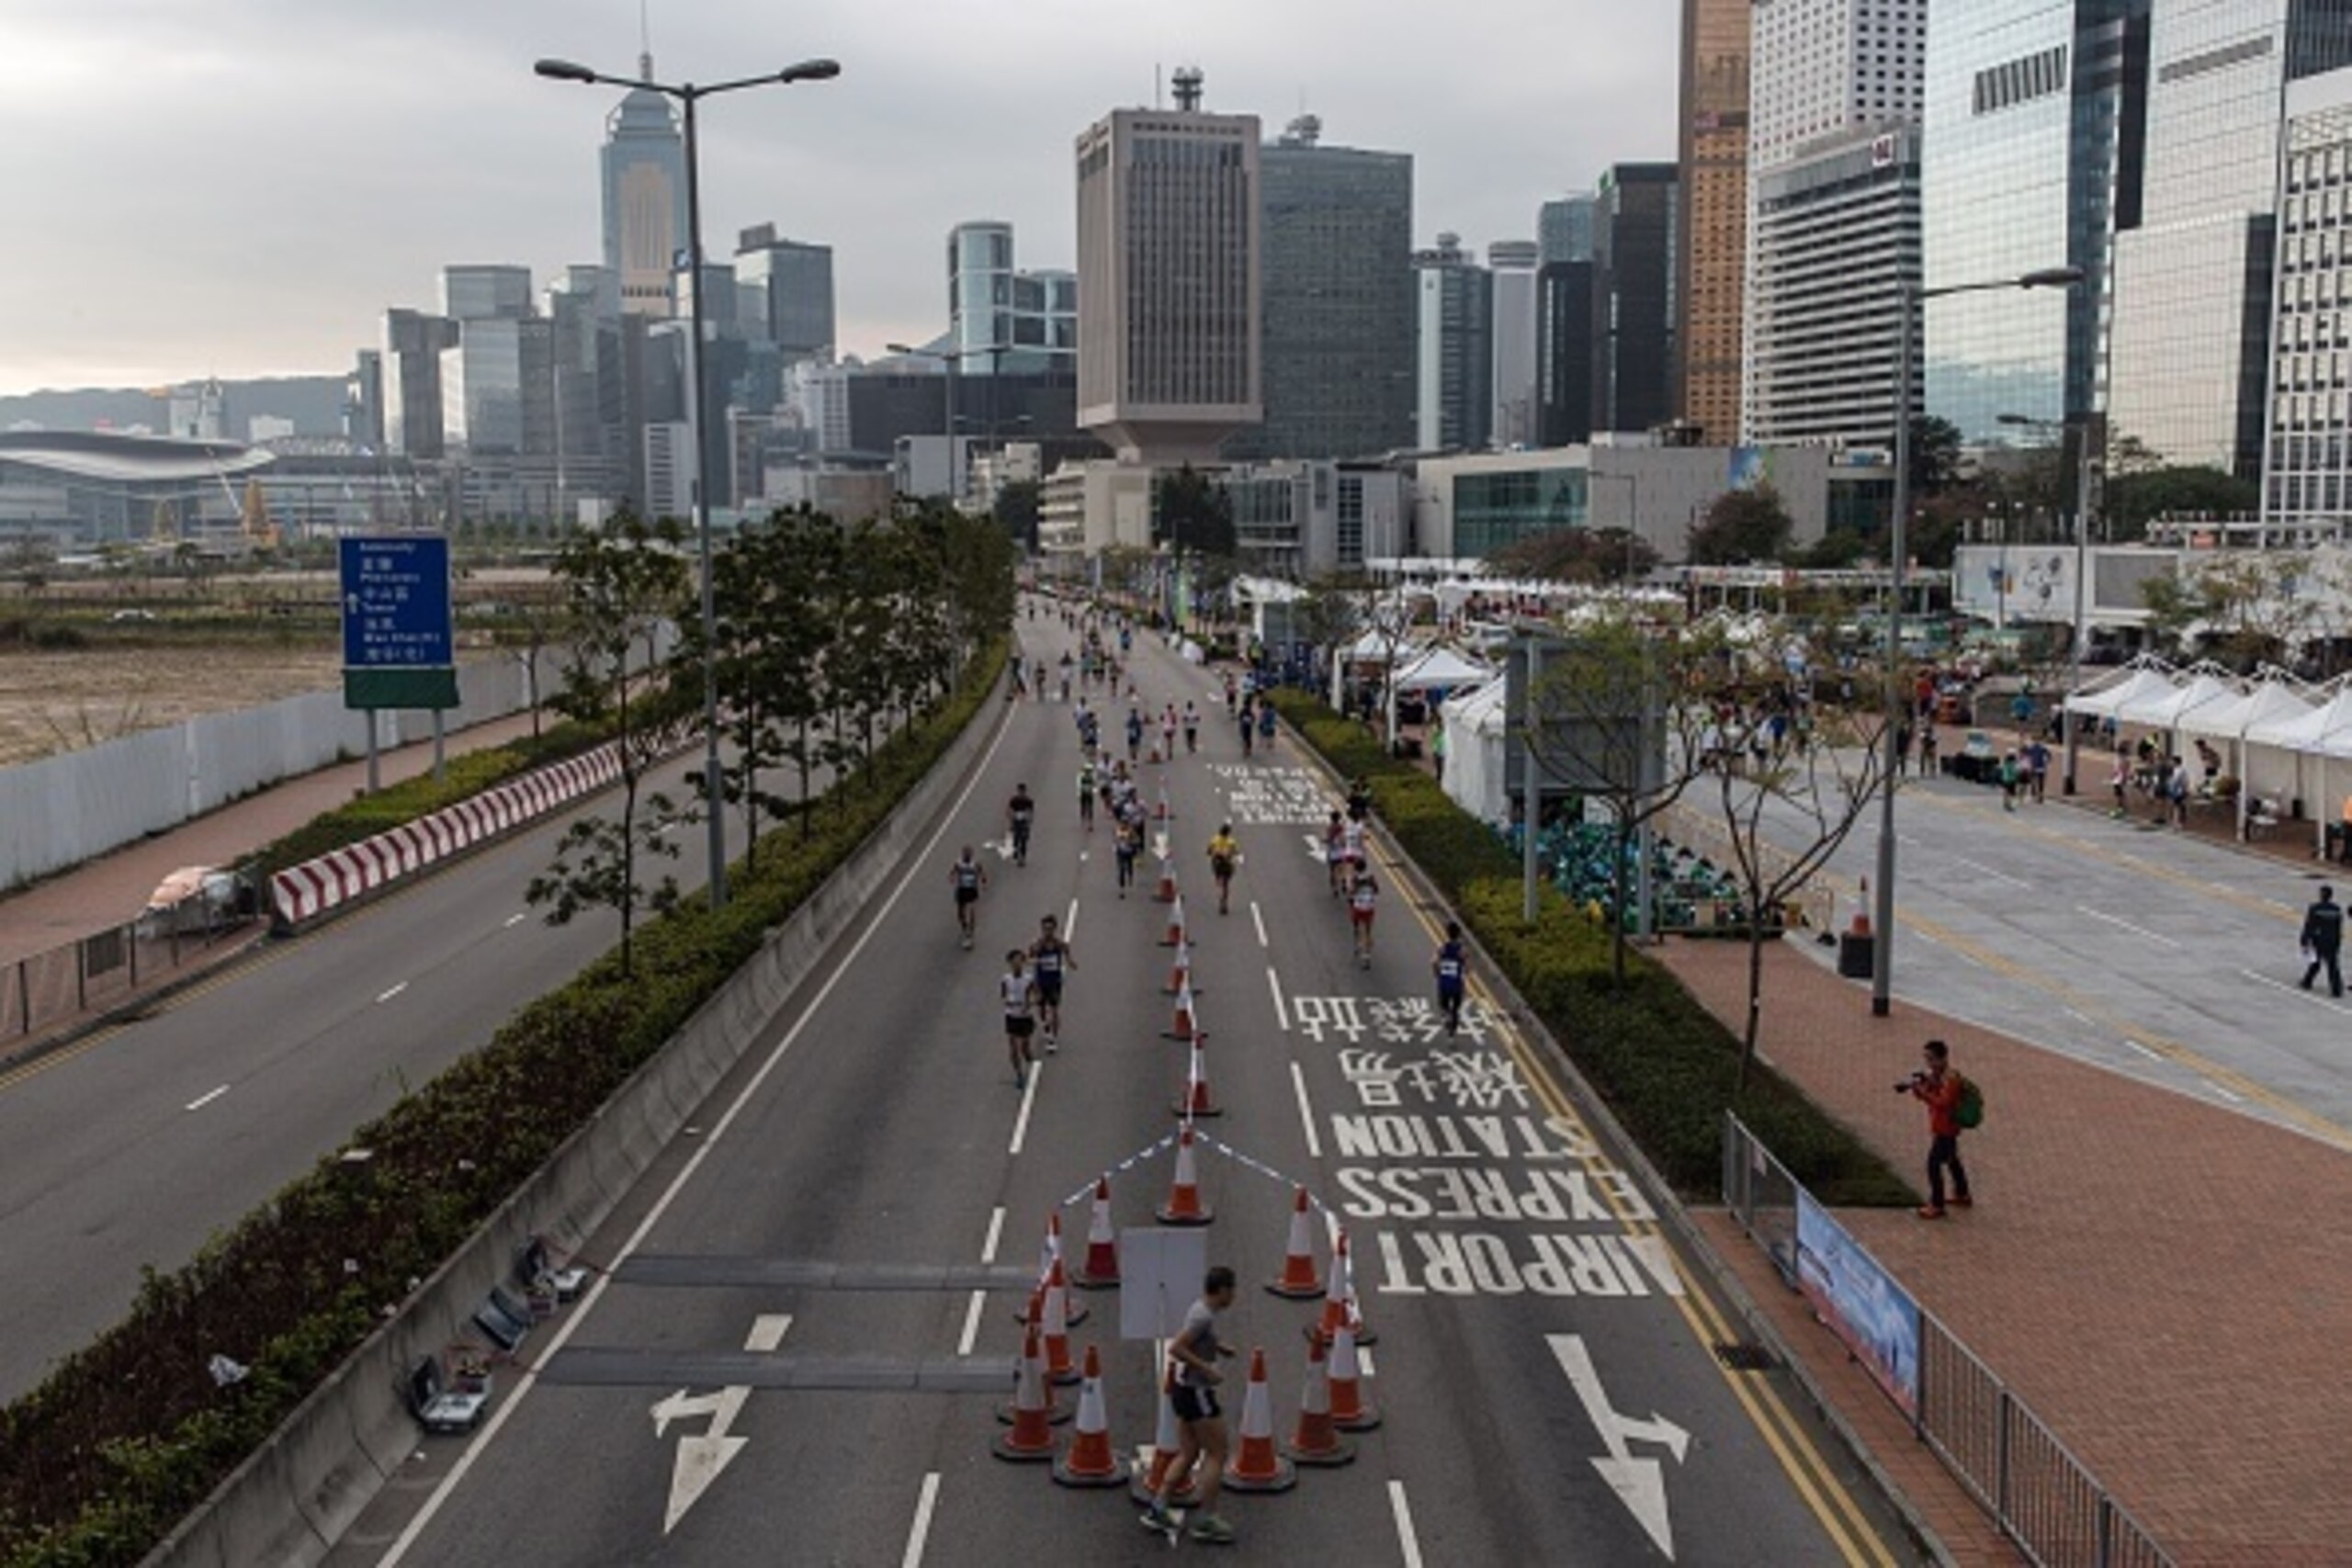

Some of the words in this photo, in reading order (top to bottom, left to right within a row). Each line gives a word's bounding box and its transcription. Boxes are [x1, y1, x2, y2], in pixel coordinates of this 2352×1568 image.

[1339, 1049, 1529, 1108] 機場
[1330, 1114, 1600, 1158] STATION
[1337, 1168, 1658, 1221] EXPRESS
[1378, 1232, 1686, 1296] AIRPORT
